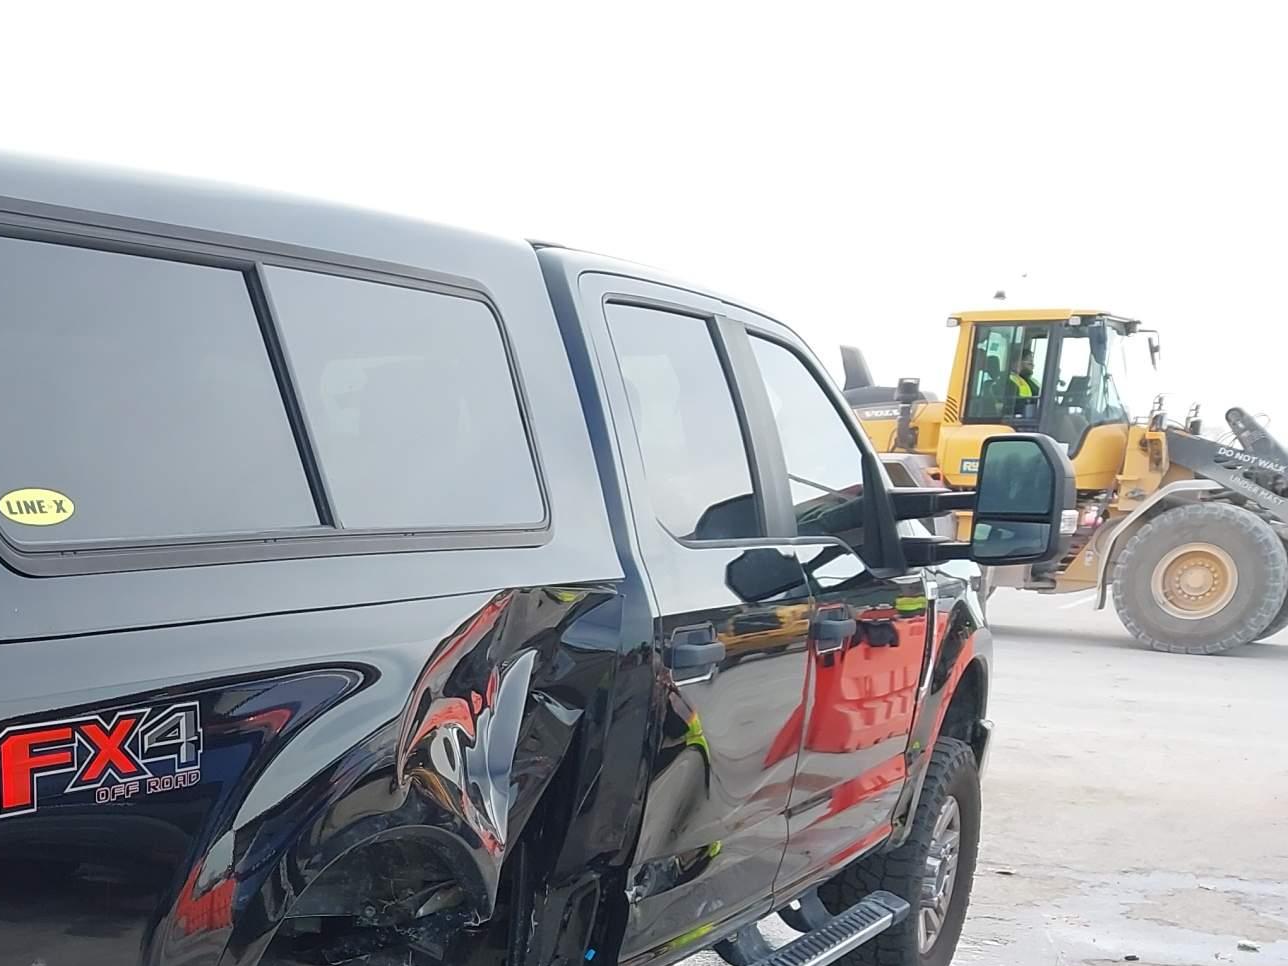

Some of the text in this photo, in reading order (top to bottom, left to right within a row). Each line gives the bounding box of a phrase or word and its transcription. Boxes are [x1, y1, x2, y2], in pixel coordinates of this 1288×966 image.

[1218, 447, 1287, 473] DO NOT WALK
[96, 769, 201, 804] OFF ROAD
